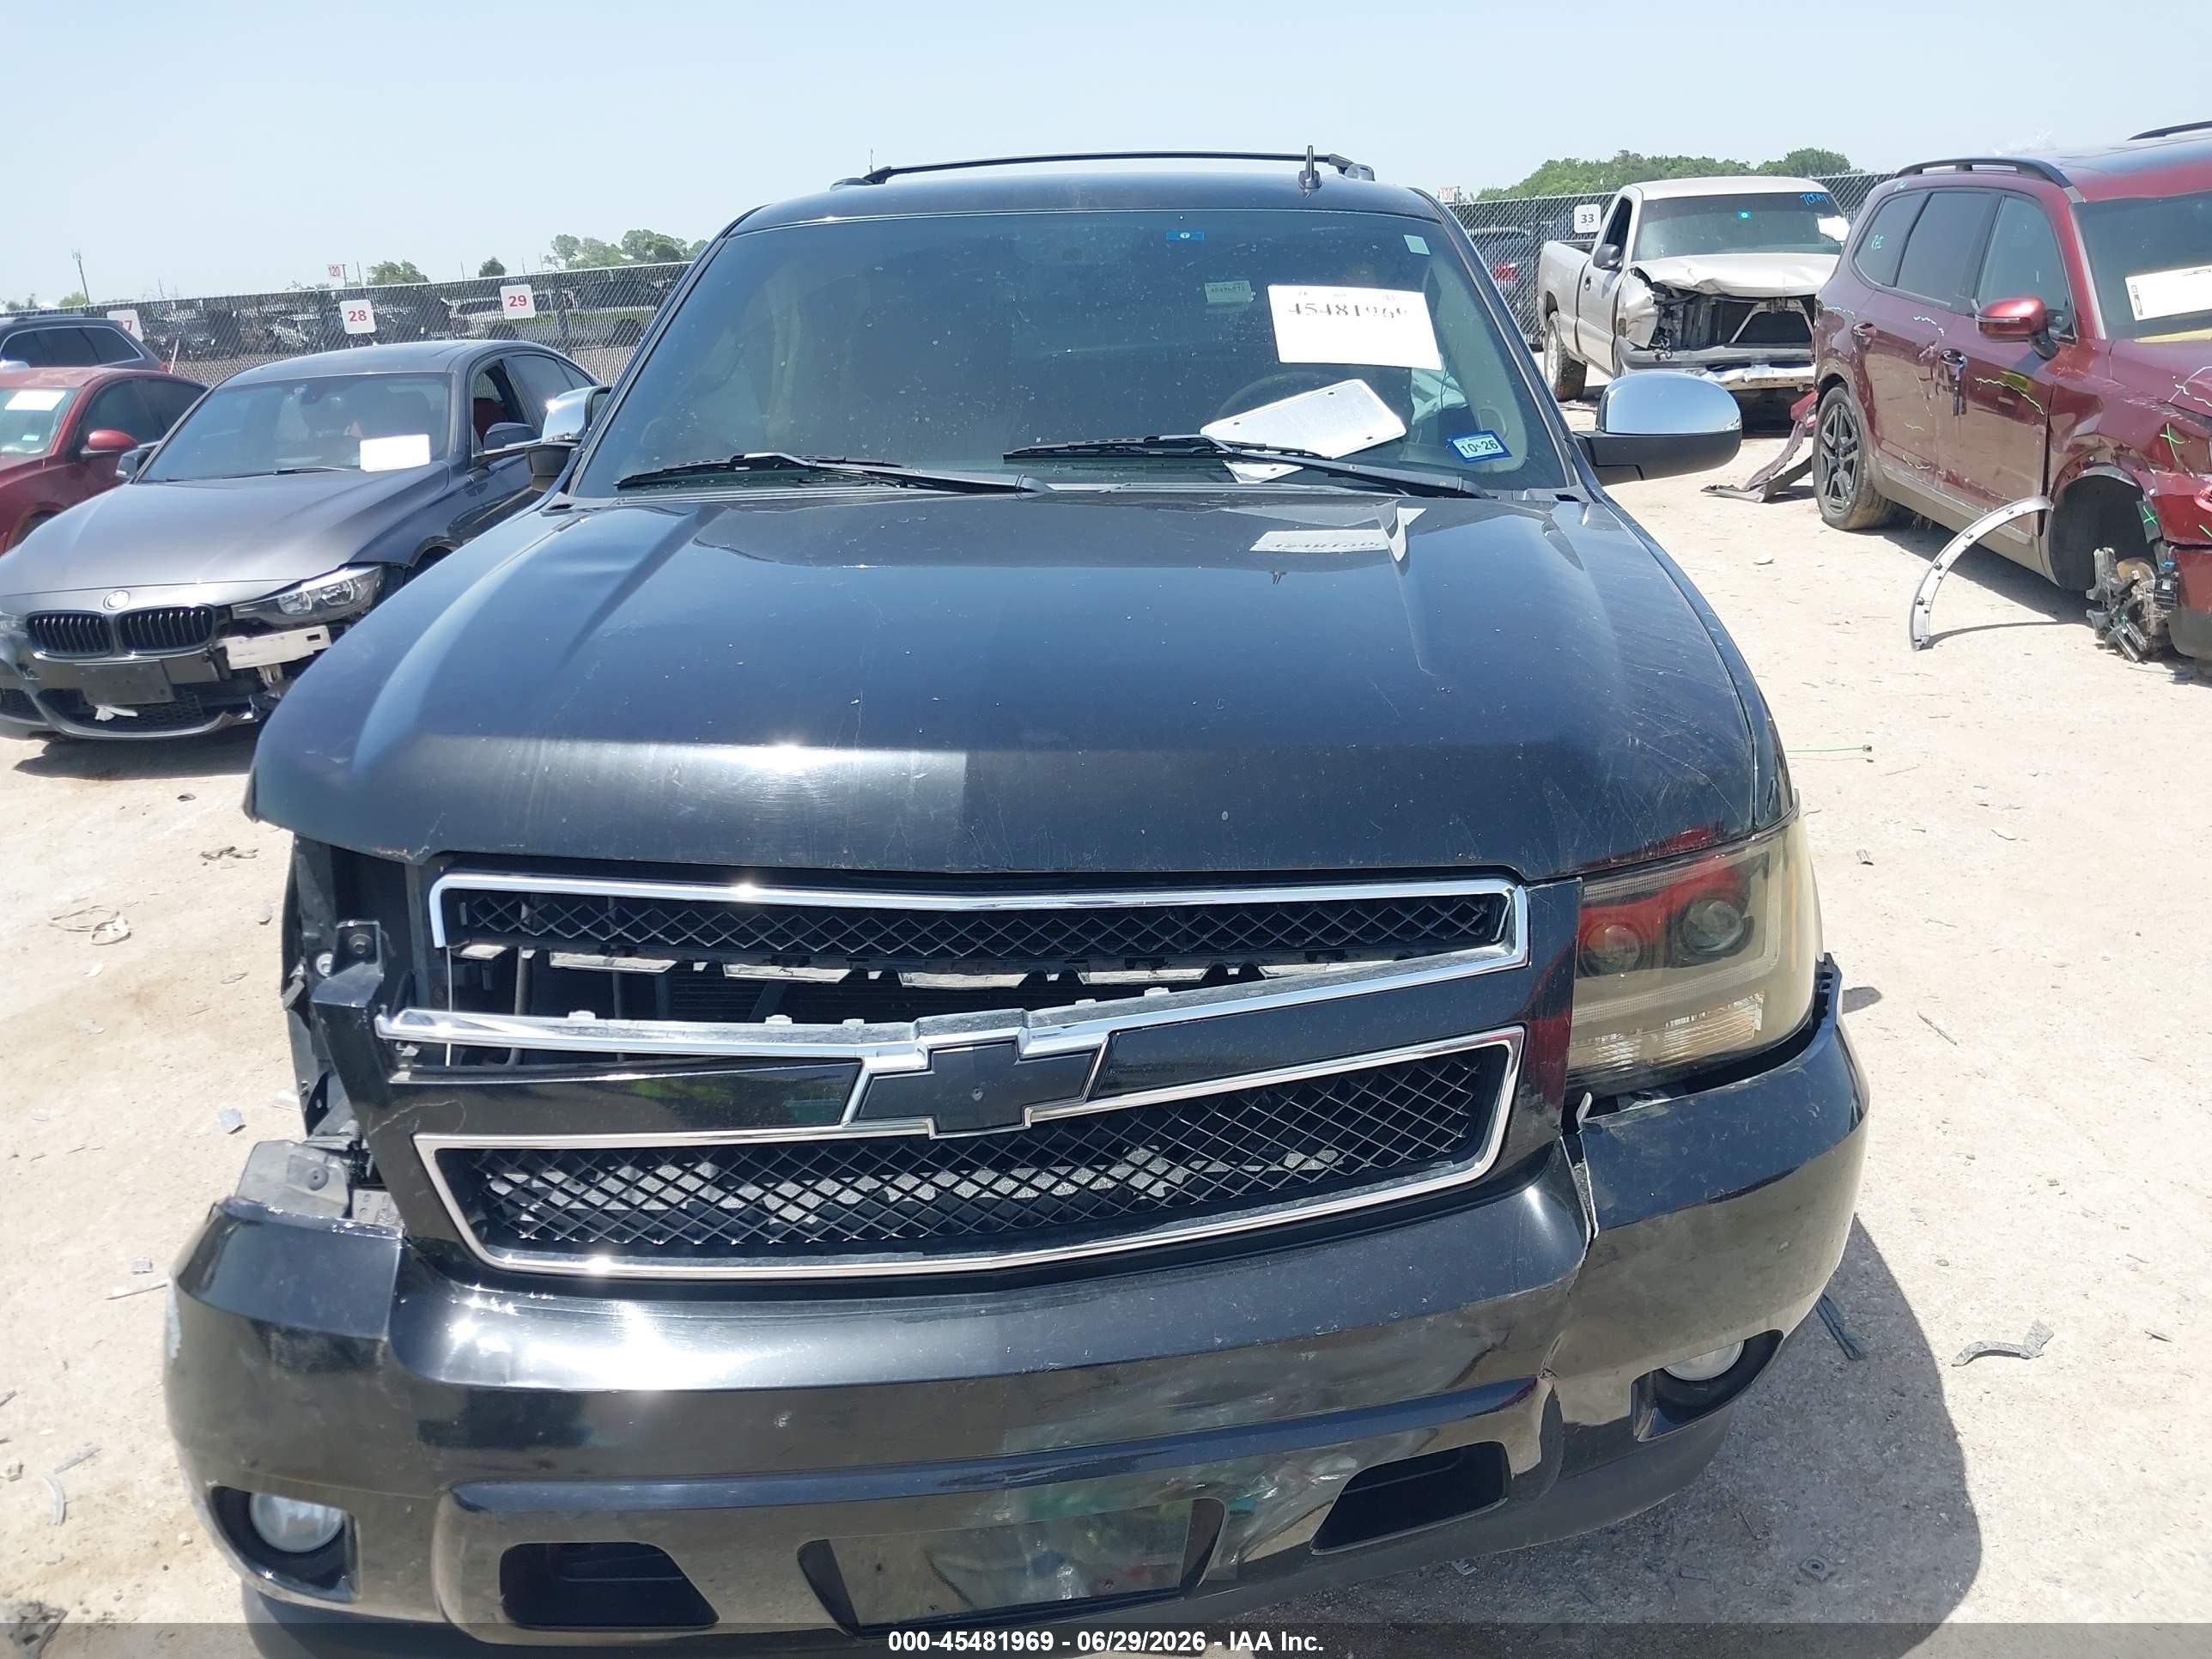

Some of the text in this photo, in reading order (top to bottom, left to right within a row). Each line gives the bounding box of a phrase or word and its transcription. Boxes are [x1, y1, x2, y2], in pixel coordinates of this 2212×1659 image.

[1580, 214, 1595, 224] 33
[508, 295, 527, 307] 29
[348, 309, 368, 322] 28
